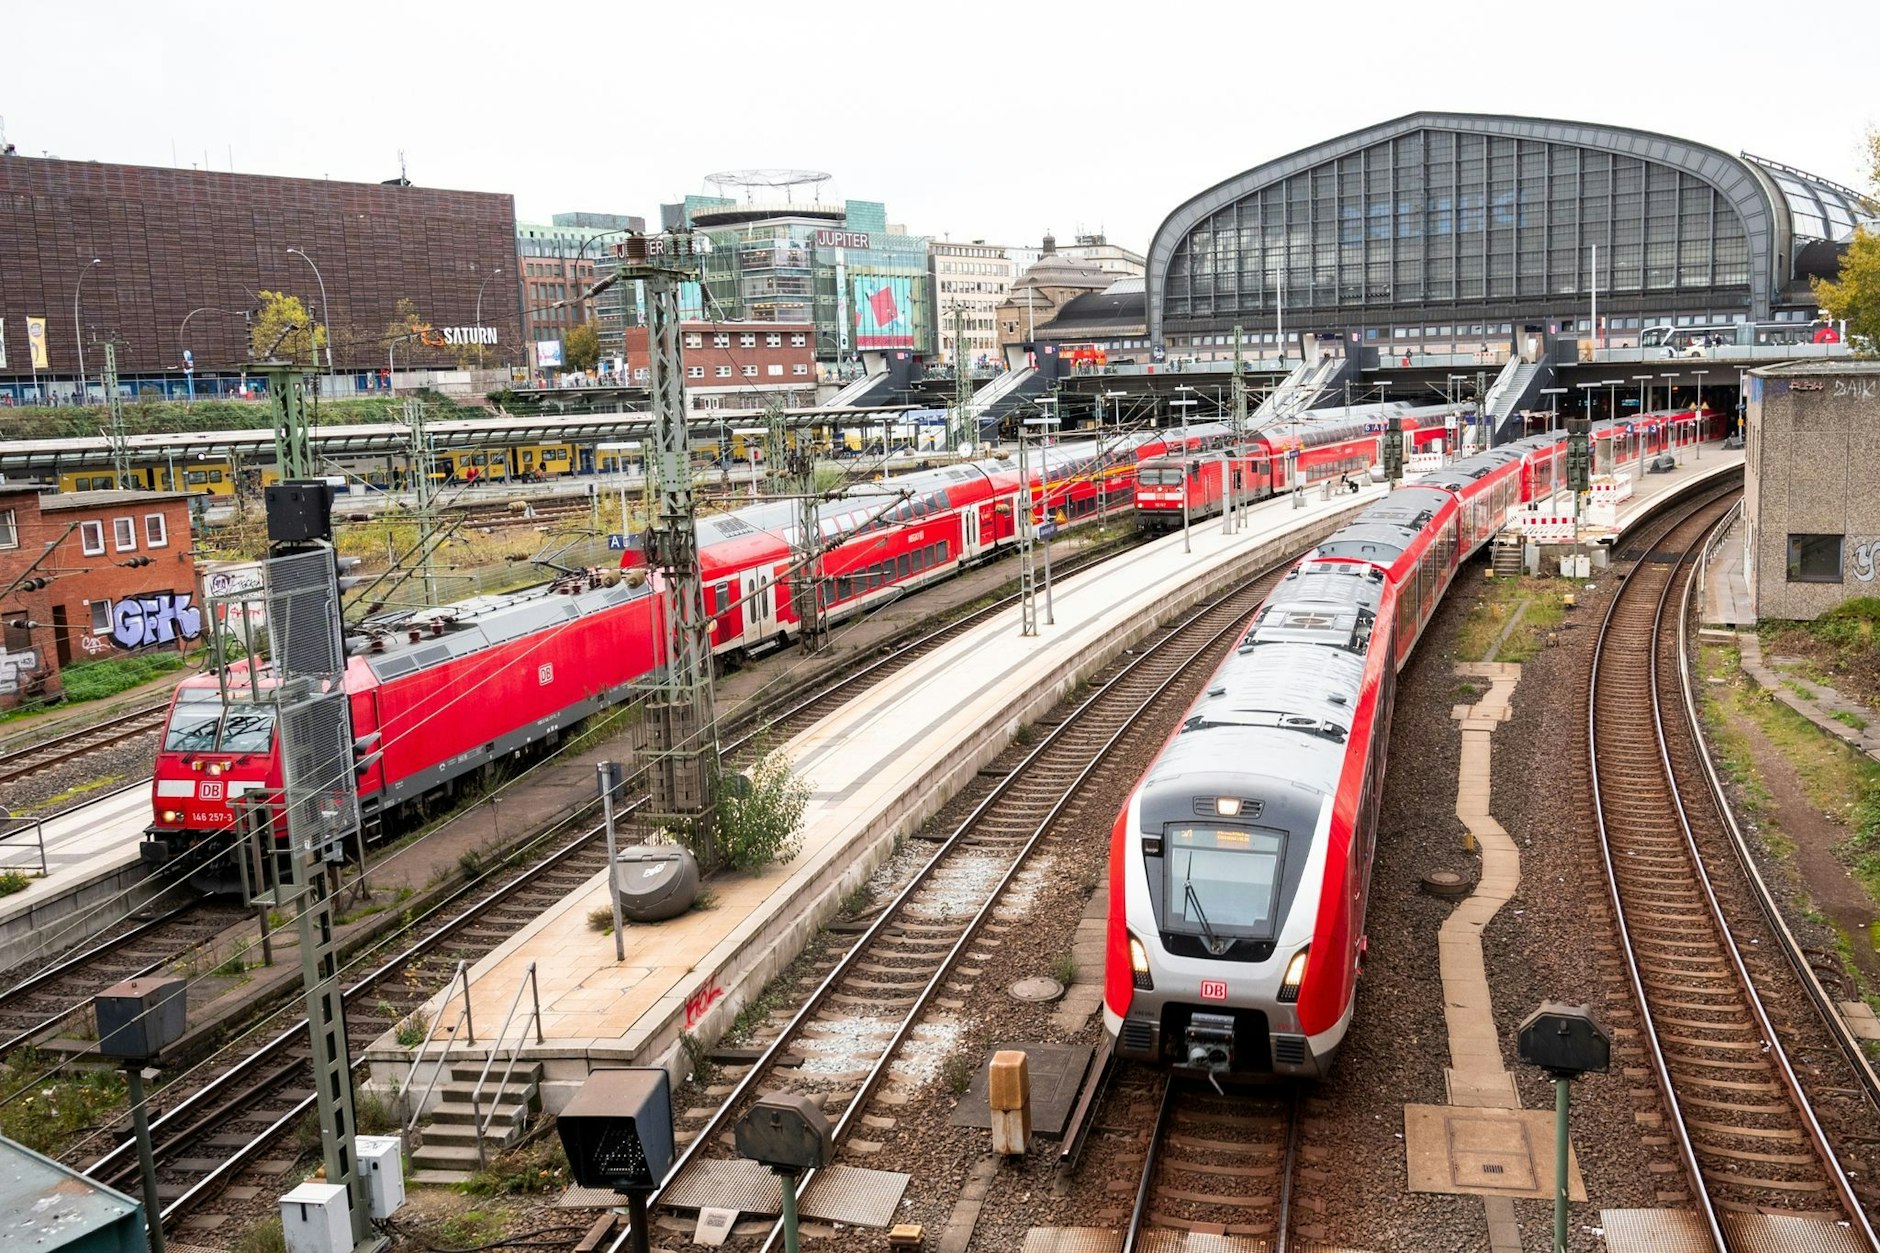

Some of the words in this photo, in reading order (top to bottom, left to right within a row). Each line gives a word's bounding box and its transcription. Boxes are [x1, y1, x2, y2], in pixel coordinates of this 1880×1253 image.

[818, 231, 868, 248] JUPITER
[443, 327, 498, 344] SATURN
[1650, 424, 1657, 432] 3
[610, 535, 620, 548] A
[540, 667, 551, 682] DB
[203, 784, 220, 797] DB
[192, 813, 207, 821] 146
[209, 813, 233, 821] 257-3
[1203, 983, 1223, 997] DB
